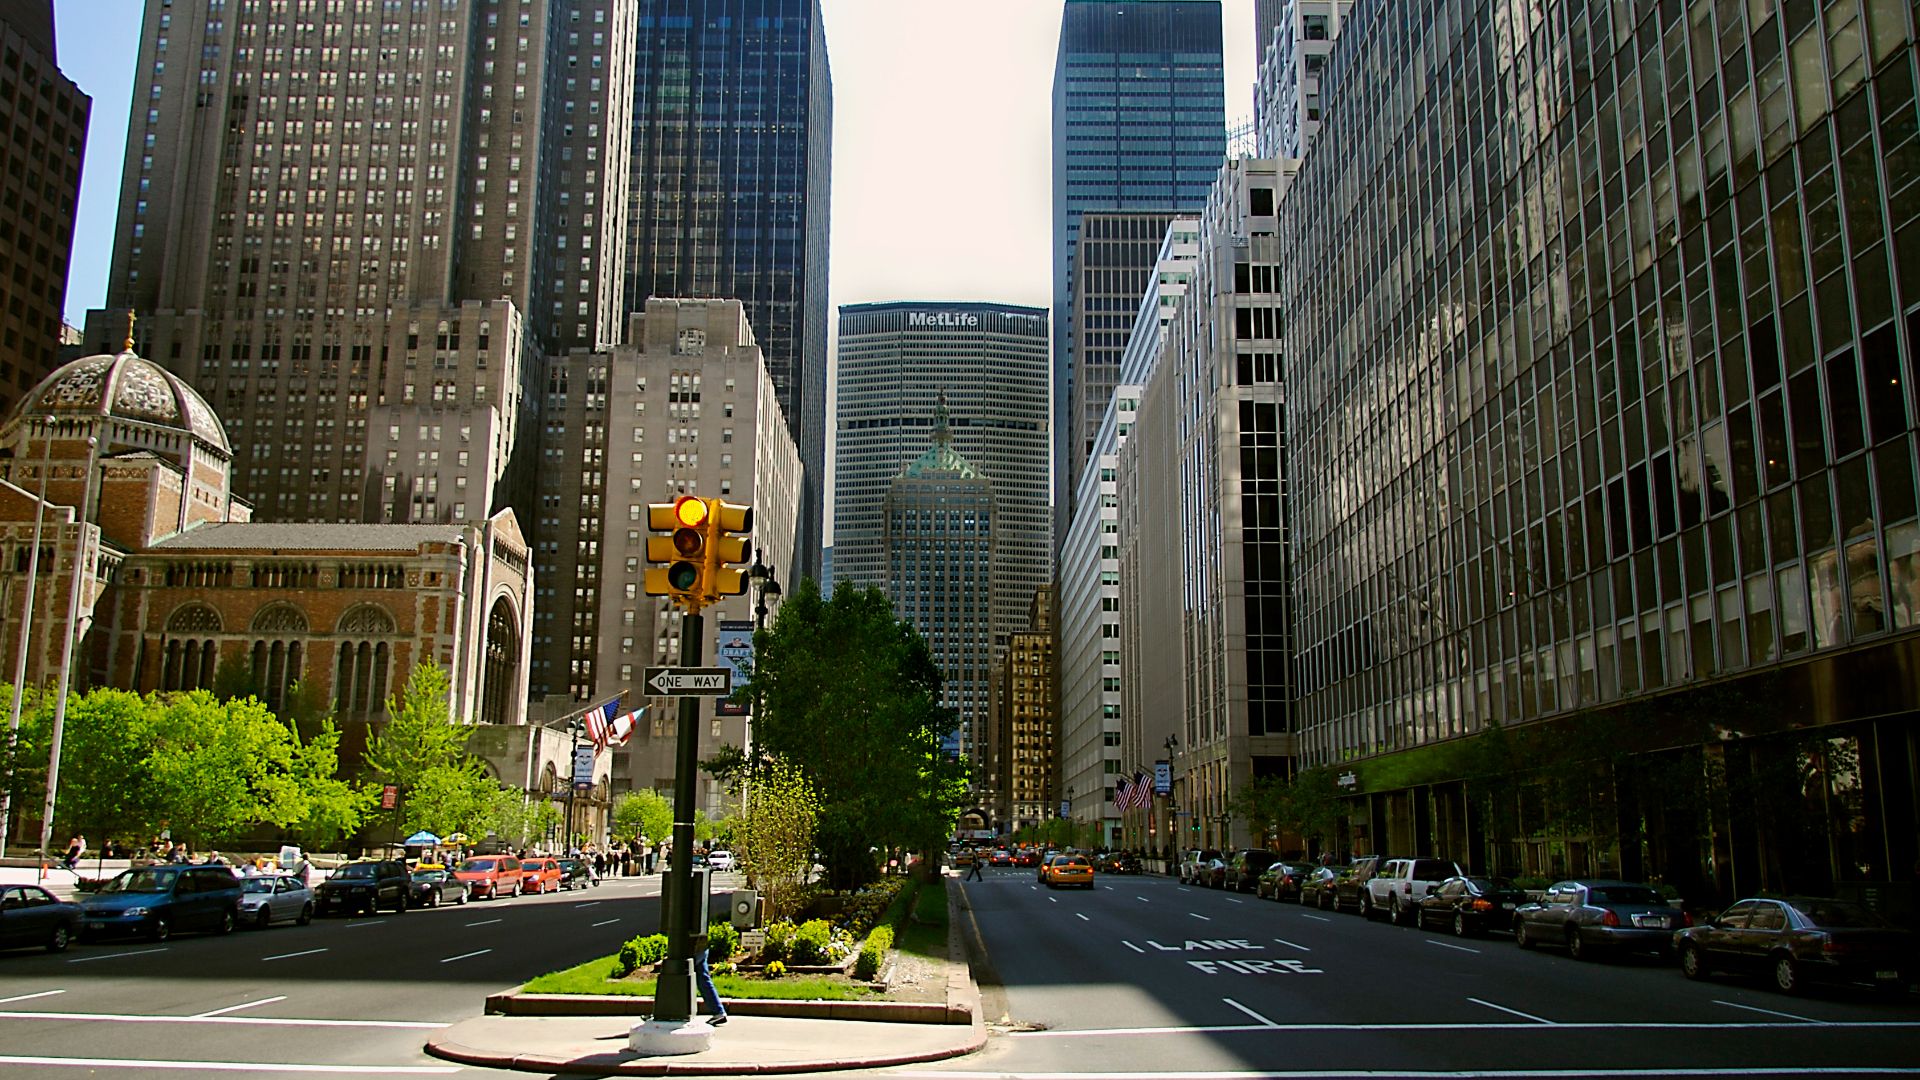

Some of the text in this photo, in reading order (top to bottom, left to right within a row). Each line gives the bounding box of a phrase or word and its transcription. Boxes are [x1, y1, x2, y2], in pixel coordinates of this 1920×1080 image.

[909, 312, 978, 326] MetLife
[657, 676, 720, 687] ONE WAY
[1146, 939, 1265, 951] LANE
[1186, 960, 1325, 974] FIRE
